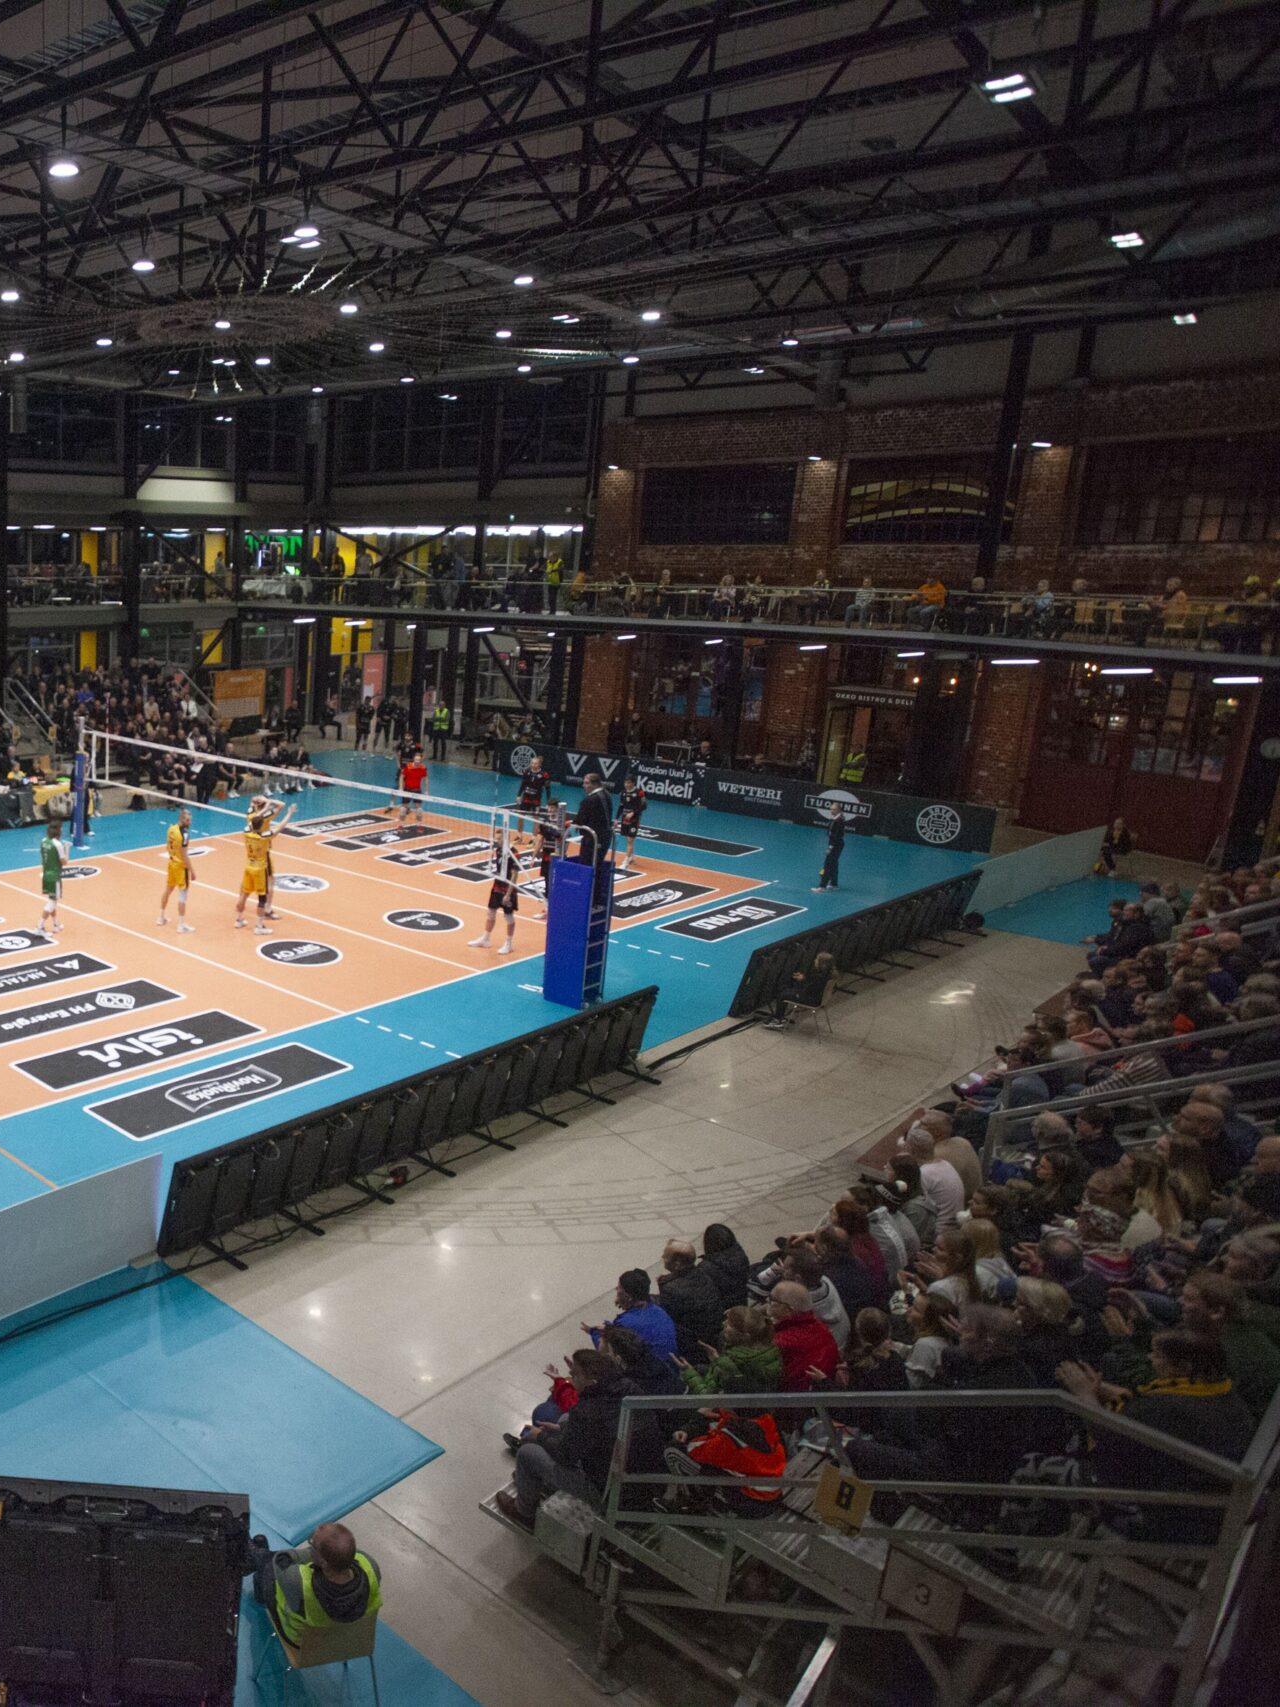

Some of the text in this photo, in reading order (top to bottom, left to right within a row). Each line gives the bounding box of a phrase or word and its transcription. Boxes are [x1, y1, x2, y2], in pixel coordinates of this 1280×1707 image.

[894, 698, 914, 706] DELI
[638, 763, 694, 780] Kuopion Uuni ja
[636, 775, 695, 799] Kaakeli
[717, 781, 783, 800] WETTERI
[808, 798, 869, 815] TUONEN
[0, 1006, 70, 1031] Energia
[185, 1073, 266, 1102] HoviRuoka
[835, 1480, 857, 1511] B
[914, 1582, 931, 1606] 3
